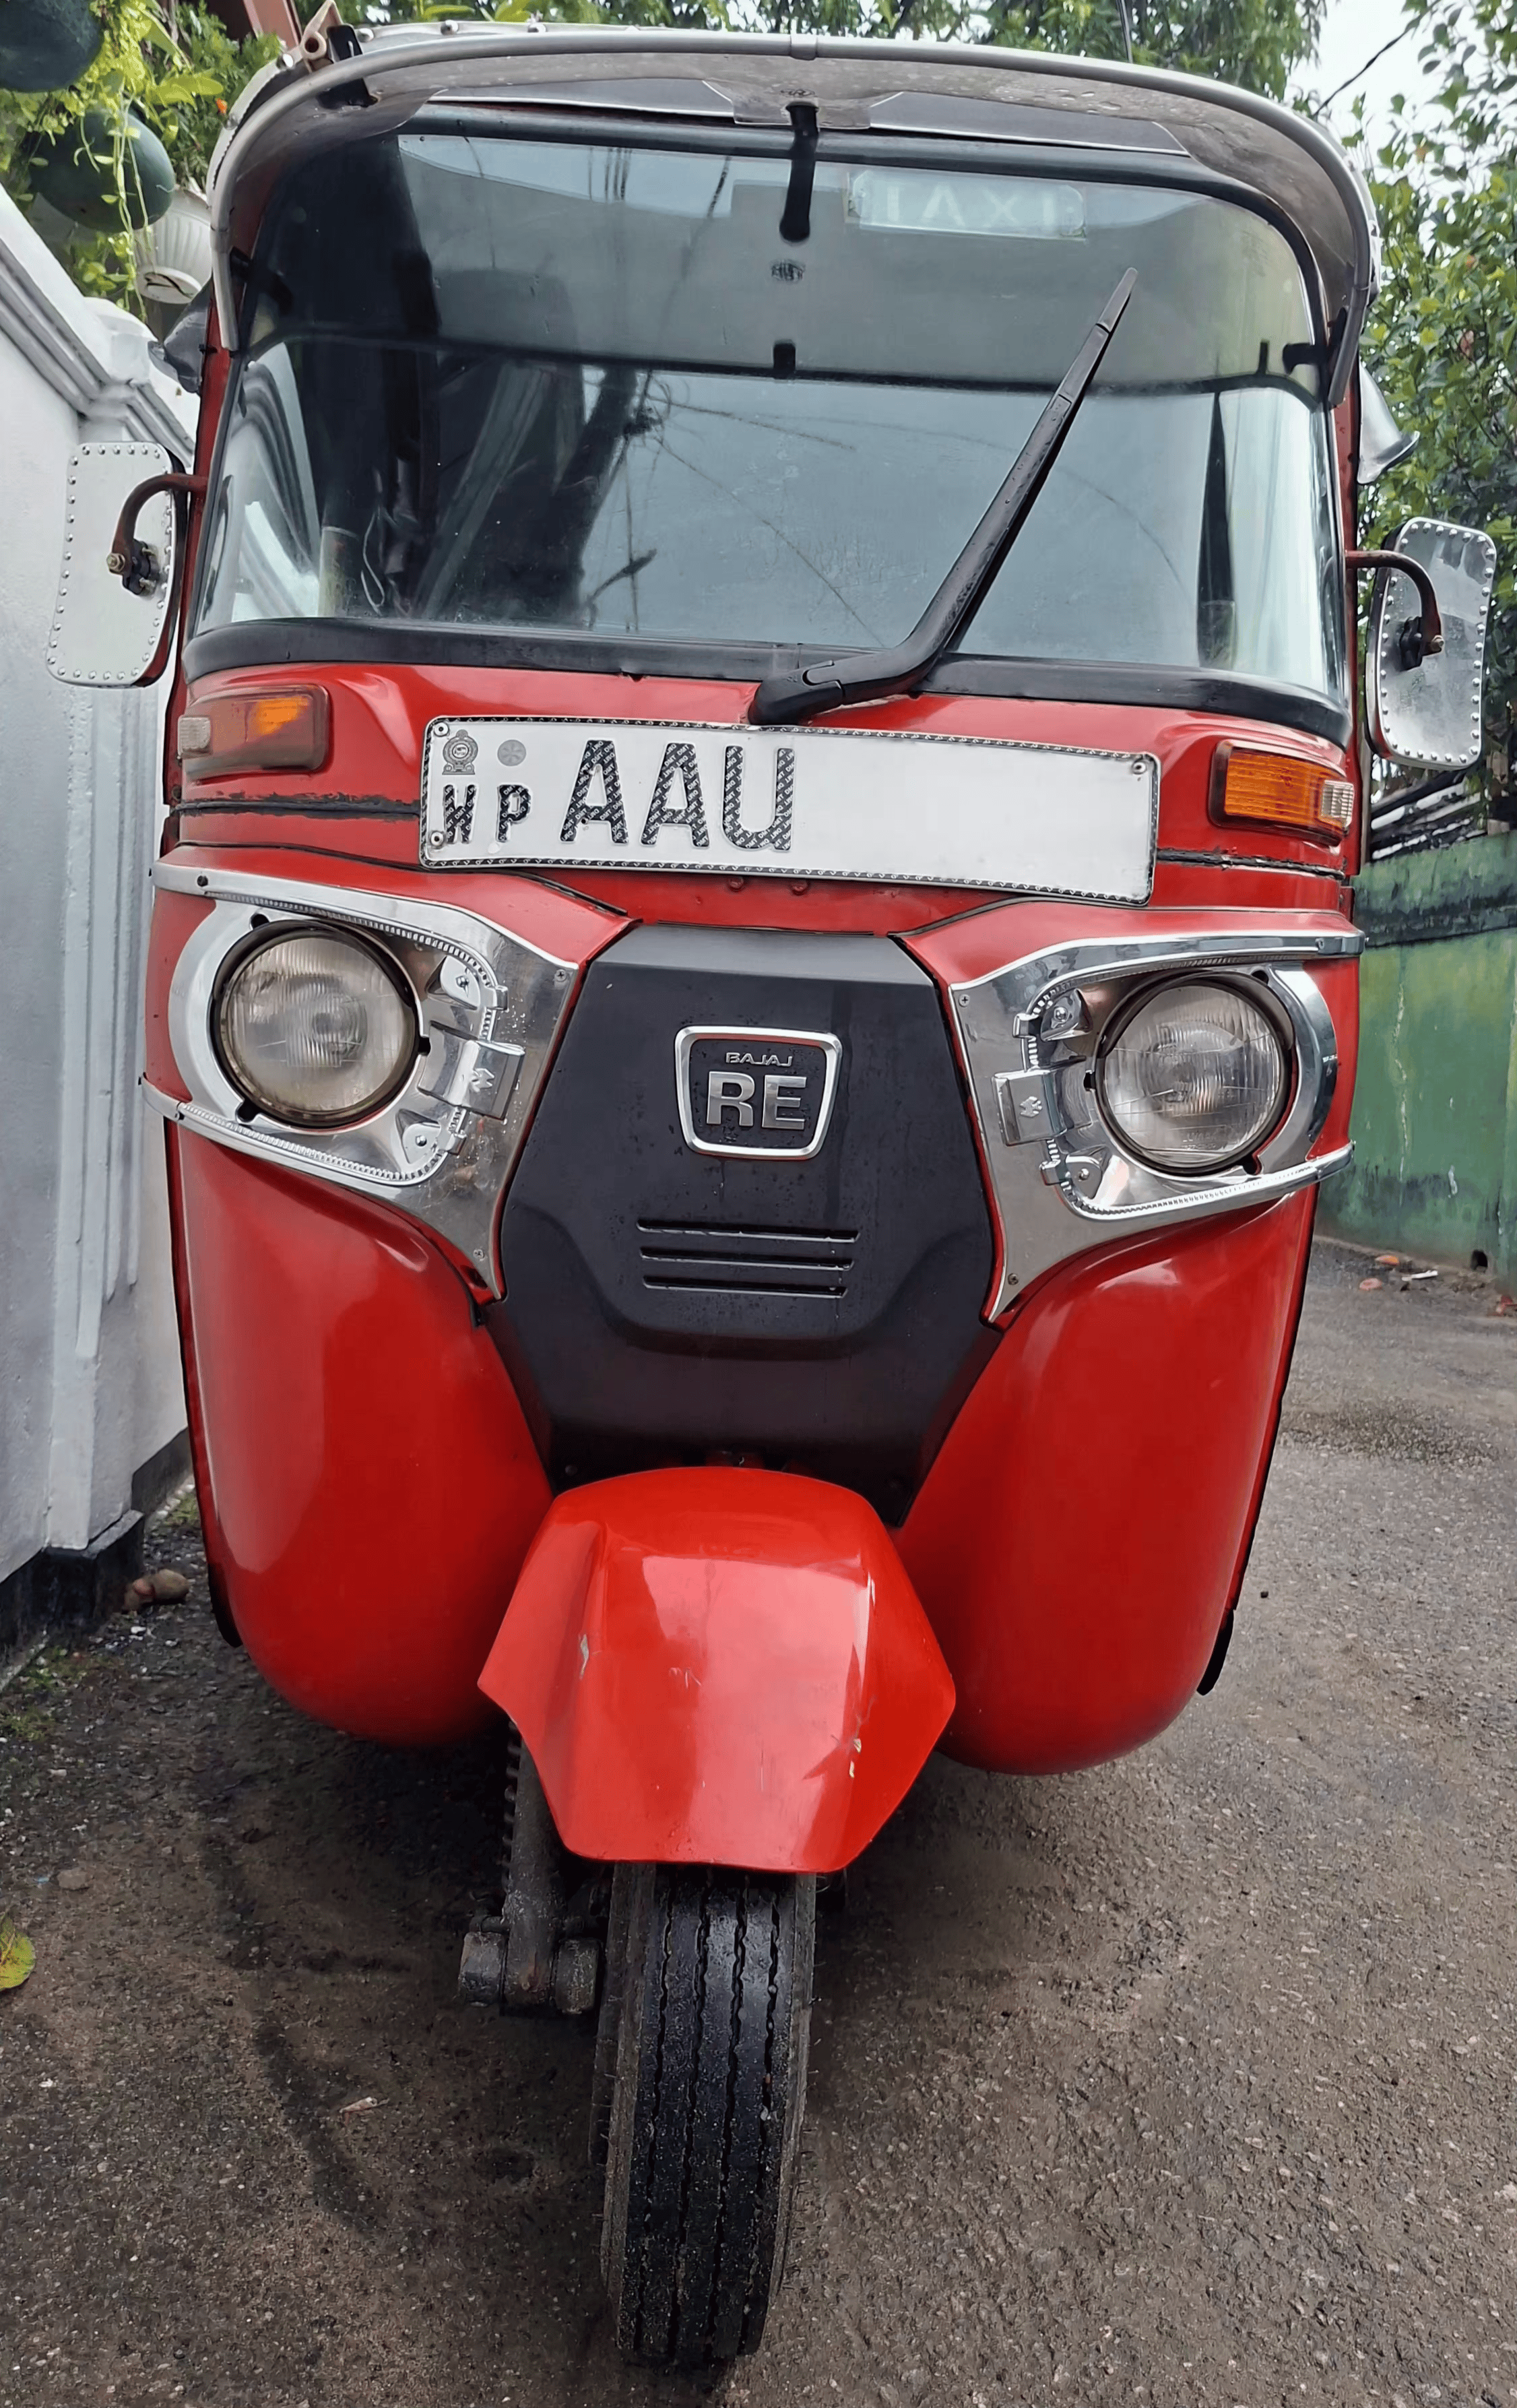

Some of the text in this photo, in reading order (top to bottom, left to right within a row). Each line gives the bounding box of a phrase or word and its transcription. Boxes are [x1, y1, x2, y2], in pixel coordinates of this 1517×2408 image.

[560, 740, 795, 852] AAU
[725, 1052, 793, 1067] BAJAJ
[707, 1071, 807, 1131] RE
